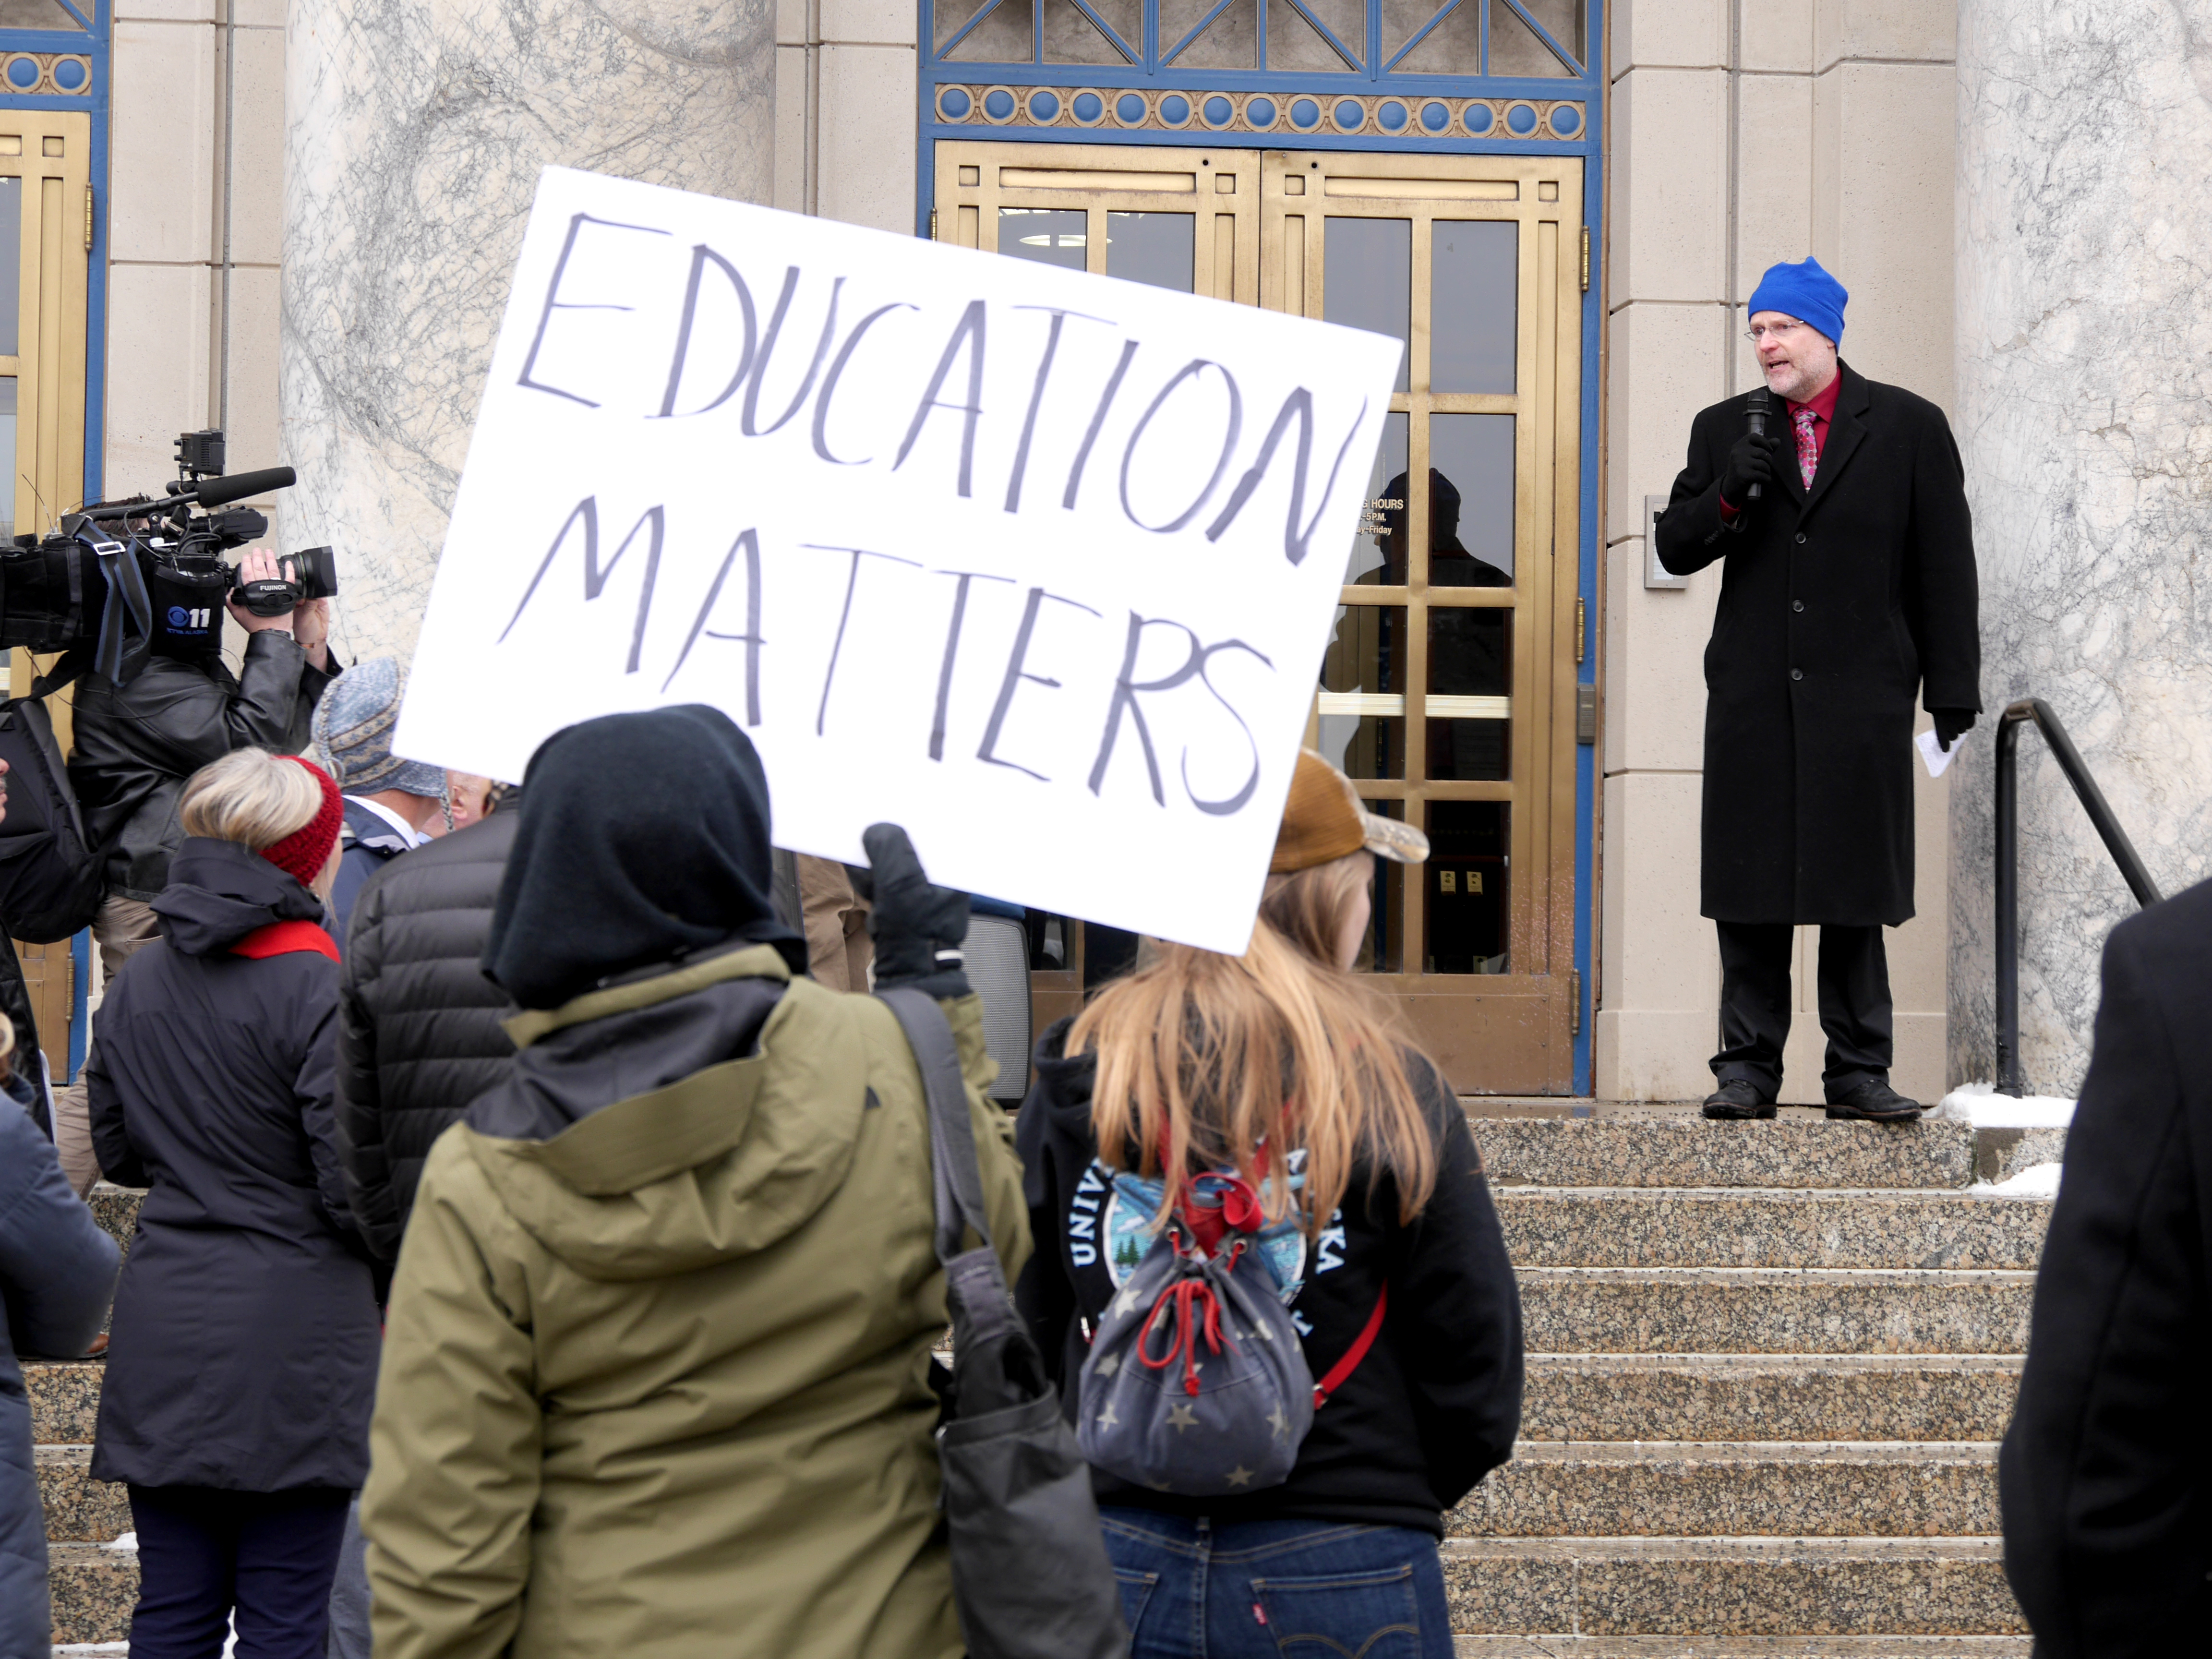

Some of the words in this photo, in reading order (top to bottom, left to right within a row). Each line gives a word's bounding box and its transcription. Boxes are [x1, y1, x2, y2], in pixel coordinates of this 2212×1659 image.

[516, 212, 1368, 567] EDUCATION
[1371, 499, 1404, 509] HOURS
[1357, 526, 1392, 535] ay-Friday
[189, 608, 211, 628] 11
[497, 494, 1277, 817] MATTERS
